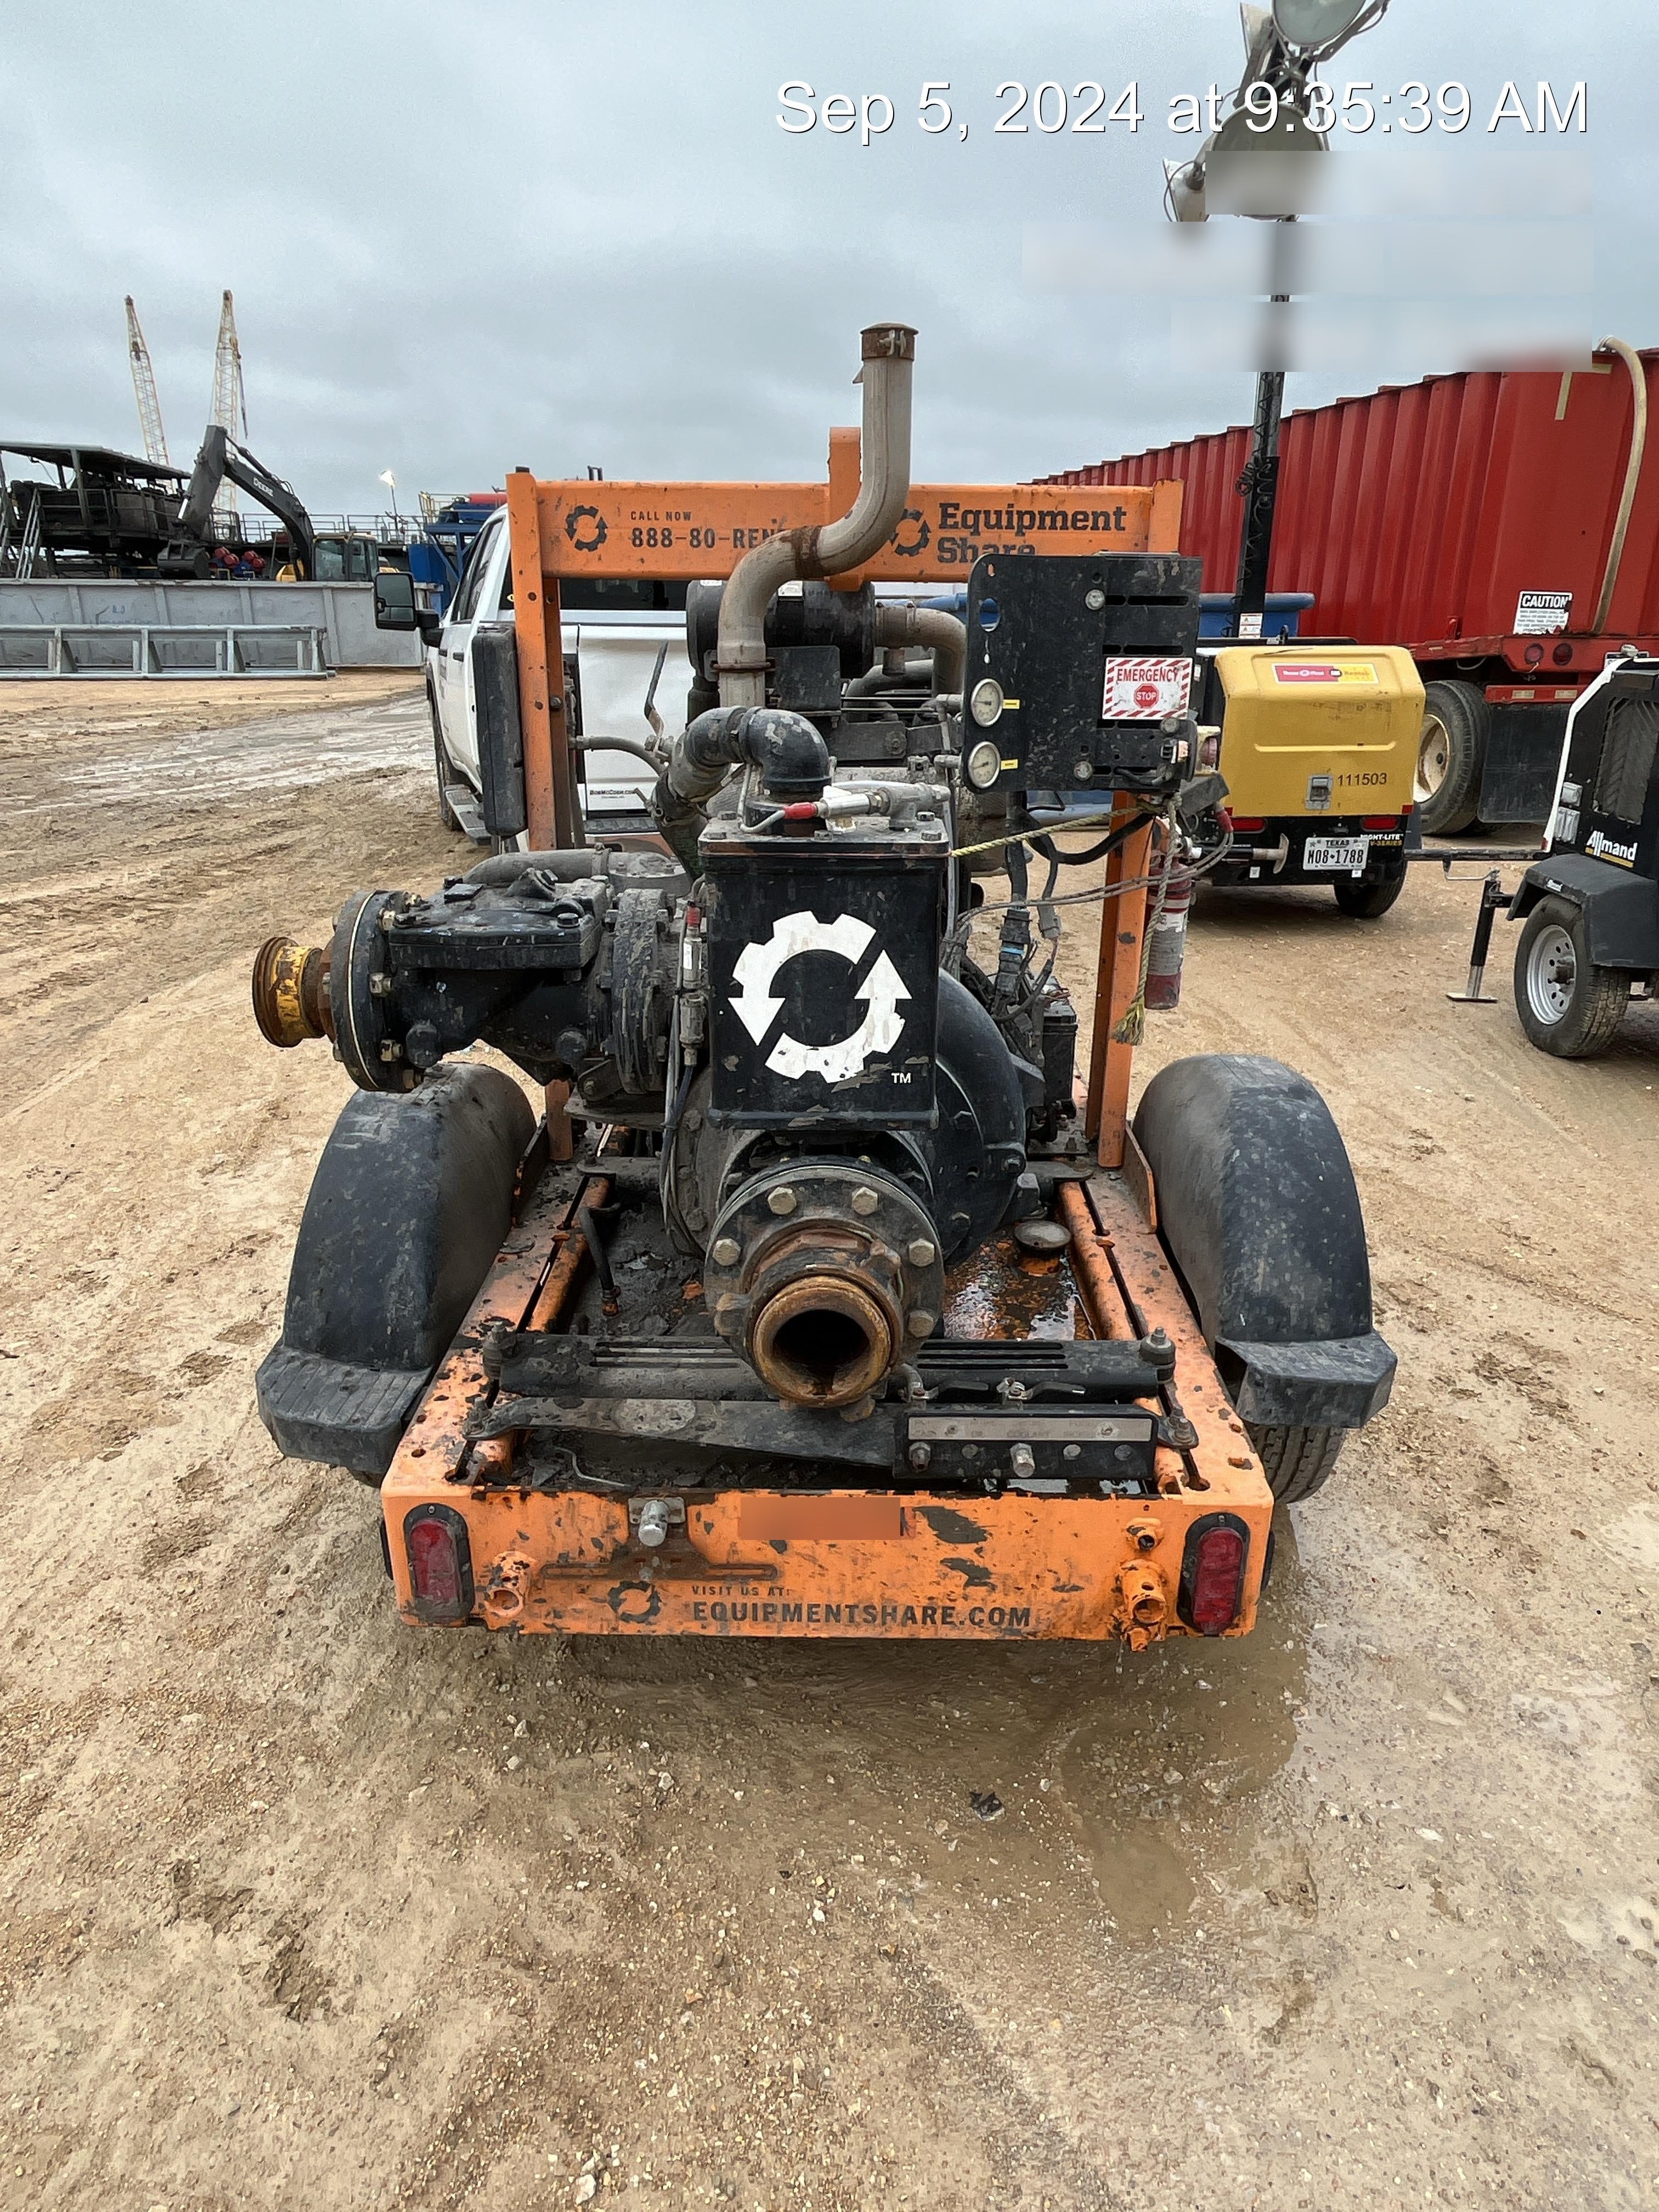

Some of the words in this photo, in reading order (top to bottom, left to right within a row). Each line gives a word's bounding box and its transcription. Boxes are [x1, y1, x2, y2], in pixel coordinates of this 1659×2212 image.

[630, 511, 659, 521] CALL
[665, 511, 692, 521] NOW
[939, 503, 1126, 537] Equipment
[631, 527, 792, 549] 888-80-REN
[1522, 595, 1569, 608] CAUTION
[1117, 667, 1179, 682] EMERGENCY
[1136, 691, 1157, 701] STOP
[1338, 772, 1387, 786] 111503
[1586, 830, 1638, 861] Allmand
[891, 1072, 912, 1084] TM
[692, 1585, 732, 1595] VISIT
[741, 1587, 759, 1596] US
[693, 1601, 1030, 1627] EQUIPMENTSHARE.COM
